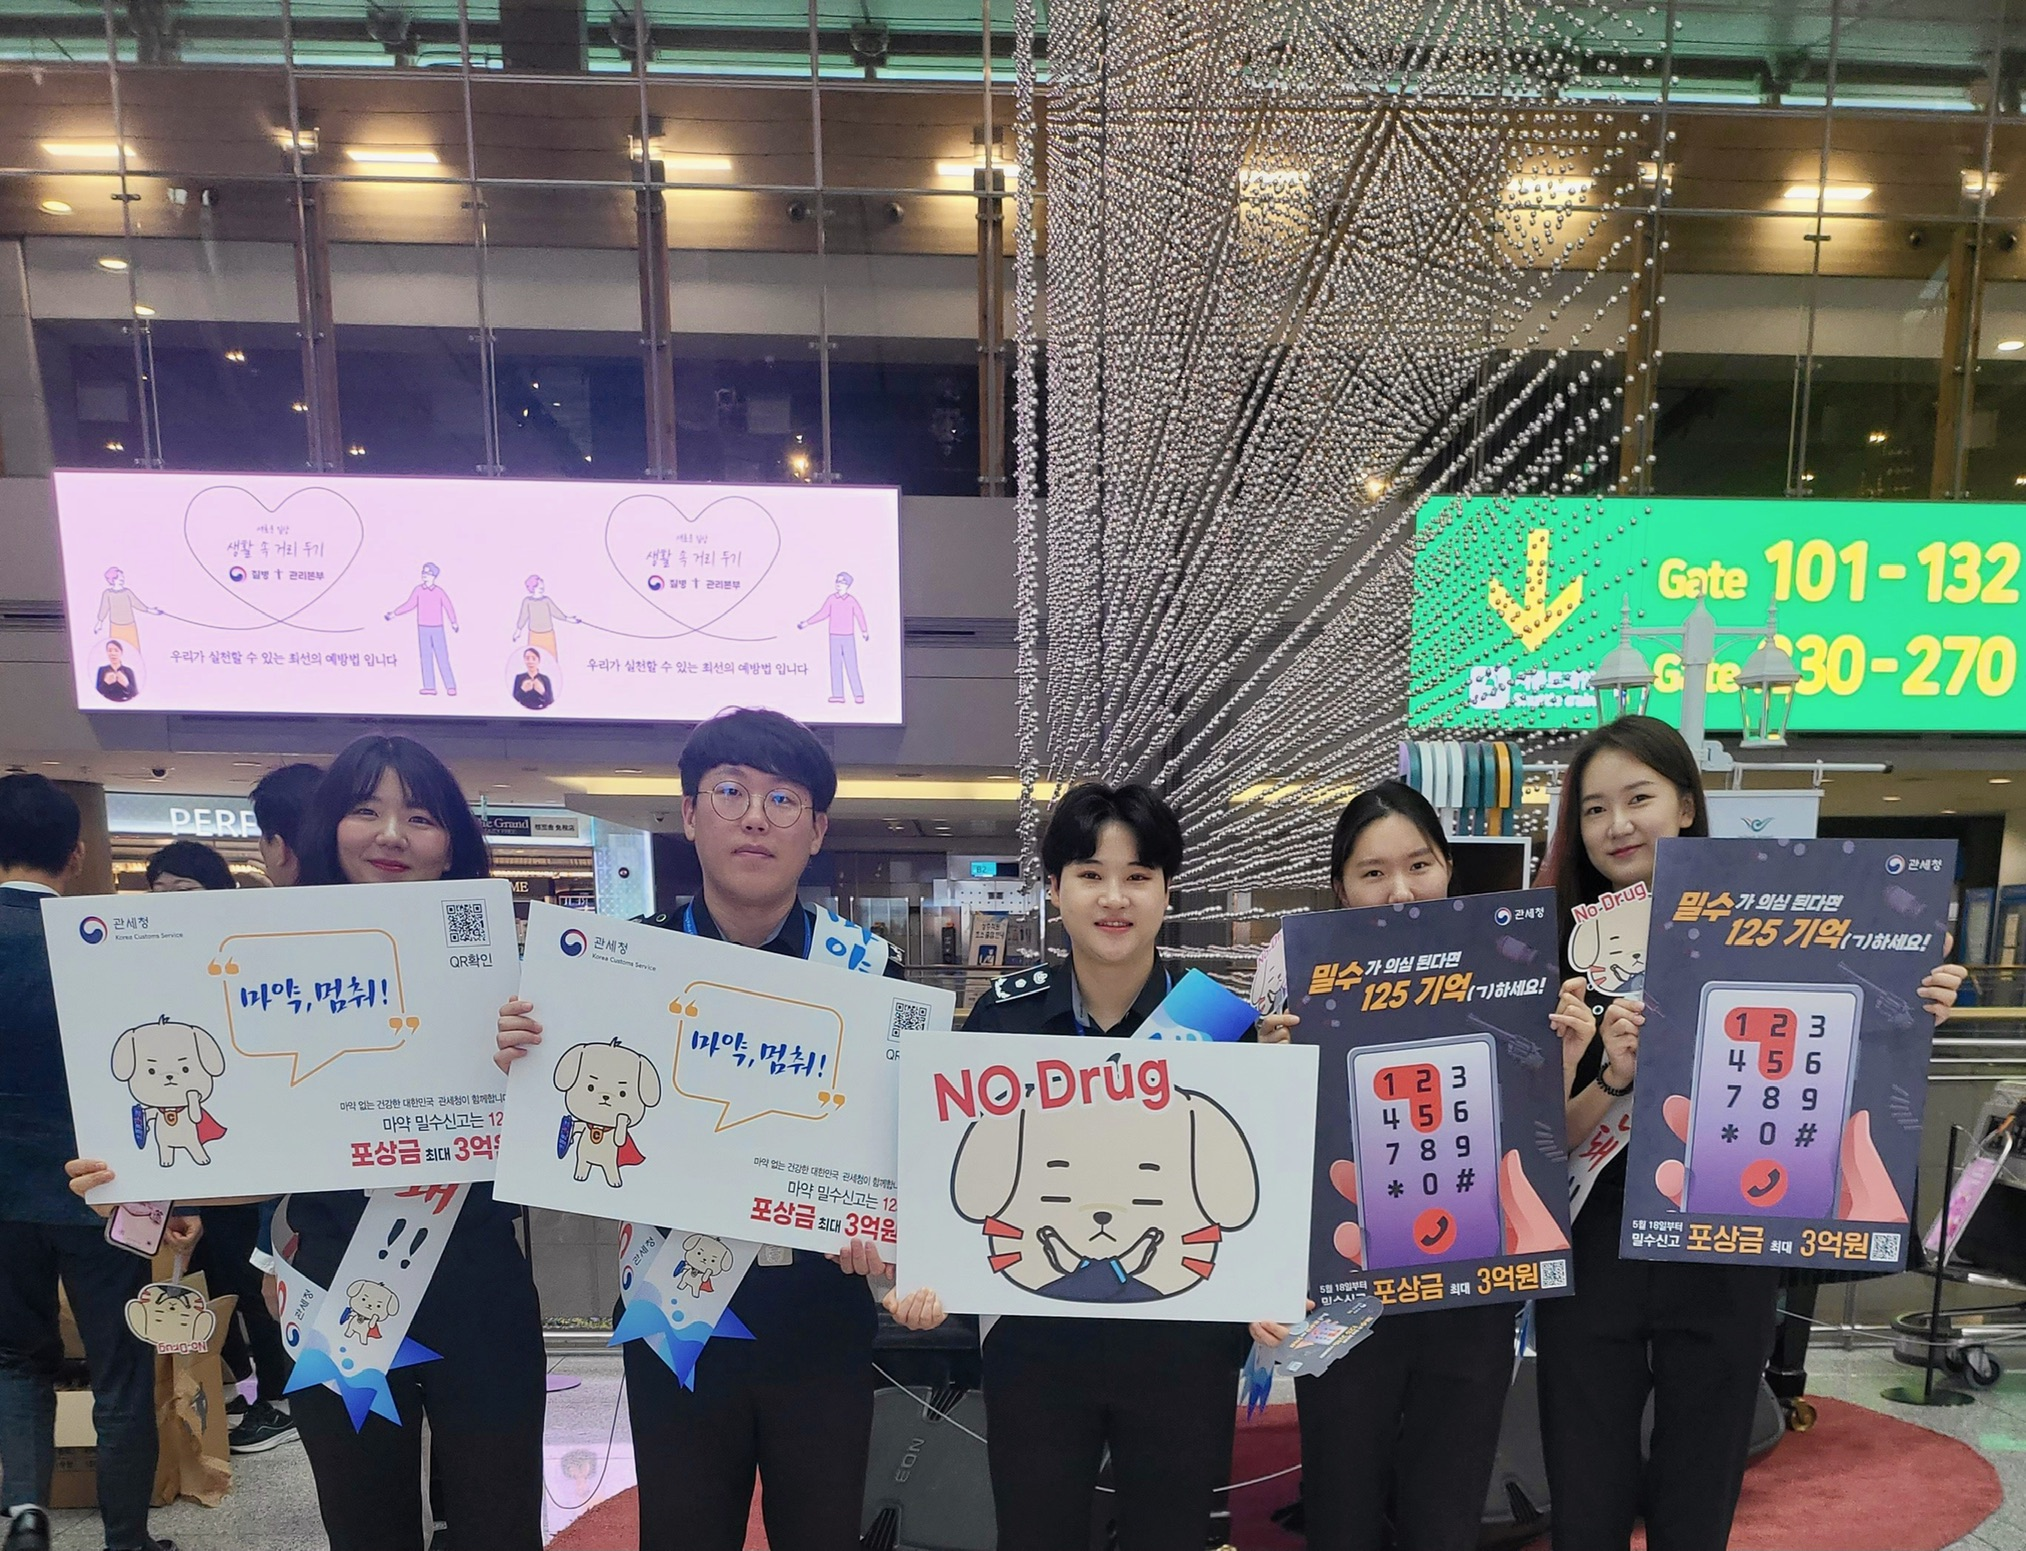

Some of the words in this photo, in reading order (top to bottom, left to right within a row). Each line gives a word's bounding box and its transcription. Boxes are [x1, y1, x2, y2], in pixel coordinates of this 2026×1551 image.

[227, 539, 254, 558] 생활
[260, 541, 269, 558] 속
[274, 541, 297, 557] 거리
[303, 541, 324, 557] 두기
[646, 549, 672, 568] 생활
[693, 550, 715, 567] 거리
[721, 551, 742, 568] 두기
[1658, 557, 1748, 600] Gate
[170, 650, 205, 663] 우리가
[209, 651, 242, 664] 실천할
[246, 652, 258, 664] 수
[261, 652, 285, 665] 있는
[288, 652, 322, 665] 최선의
[326, 653, 360, 667] 예방법
[364, 653, 398, 667] 입니다
[587, 658, 620, 672] 우리가
[624, 659, 656, 673] 실천할
[661, 660, 673, 673] 수
[676, 661, 698, 674] 있는
[702, 661, 734, 674] 최선의
[738, 662, 771, 675] 예방법
[776, 662, 808, 676] 입니다
[1652, 652, 1742, 694] Gte
[494, 818, 529, 829] Grand
[1908, 858, 1942, 871] 관세청
[1514, 906, 1545, 920] 관세청
[1755, 894, 1791, 911] 의심
[1790, 894, 1844, 912] 된다면
[113, 917, 149, 930] 관세청
[134, 932, 160, 940] Customs
[1724, 918, 1784, 947] 125
[594, 936, 628, 955] 관세청
[449, 952, 494, 969] QR확인
[592, 953, 608, 961] Korea
[610, 957, 634, 967] Customs
[635, 962, 656, 971] Service
[1383, 956, 1414, 975] 의심
[1416, 951, 1463, 971] 된다면
[315, 976, 390, 1014] 멈춰!
[1361, 980, 1412, 1012] 125
[1736, 1012, 1747, 1036] 1
[1770, 1013, 1788, 1037] 2
[1808, 1015, 1826, 1038] 3
[760, 1041, 828, 1078] 멈춰!
[1728, 1049, 1746, 1072] 4
[1767, 1050, 1783, 1073] 5
[1805, 1051, 1821, 1074] 6
[934, 1064, 1021, 1122] NO
[1036, 1057, 1171, 1111] Drug
[1383, 1073, 1394, 1096] 1
[1417, 1069, 1431, 1093] 2
[1452, 1066, 1466, 1089] 3
[340, 1101, 356, 1111] 마약
[358, 1100, 375, 1111] 없는
[376, 1099, 400, 1110] 건강한
[403, 1097, 434, 1108] 대한민국
[438, 1094, 470, 1107] 관세청이
[1727, 1085, 1741, 1108] 7
[1762, 1086, 1780, 1109] 8
[1802, 1088, 1818, 1111] 9
[383, 1115, 411, 1133] 마약
[415, 1112, 485, 1132] 밀수신고는
[1383, 1108, 1400, 1130] 4
[1419, 1104, 1433, 1127] 5
[1454, 1100, 1468, 1123] 6
[1759, 1122, 1776, 1145] 0
[1794, 1123, 1818, 1148] #
[350, 1138, 421, 1167] 포상금
[425, 1147, 451, 1162] 최대
[1386, 1142, 1399, 1165] 7
[1421, 1139, 1436, 1161] 8
[1456, 1135, 1470, 1157] 9
[754, 1157, 769, 1168] 마약
[771, 1159, 786, 1171] 없는
[788, 1162, 809, 1174] 건강한
[811, 1167, 839, 1180] 대한민국
[842, 1172, 871, 1186] 관세청이
[1423, 1173, 1438, 1195] 0
[1456, 1168, 1475, 1193] #
[788, 1180, 814, 1199] 마약
[818, 1185, 879, 1210] 밀수신고는
[750, 1197, 816, 1230] 포상금
[818, 1216, 842, 1233] 최대
[1632, 1220, 1646, 1230] 5월
[1648, 1221, 1683, 1232] 18일부터
[632, 1236, 656, 1266] 관세청
[1632, 1233, 1681, 1248] 밀수신고
[1686, 1223, 1764, 1255] 포상금
[1770, 1240, 1793, 1255] 최대
[1800, 1229, 1870, 1260] 3억원
[1320, 1283, 1333, 1294] 5월
[1335, 1280, 1368, 1293] 18일부터
[1373, 1273, 1444, 1305] 포상금
[1450, 1282, 1471, 1296] 최대
[1476, 1262, 1540, 1296] 3억원
